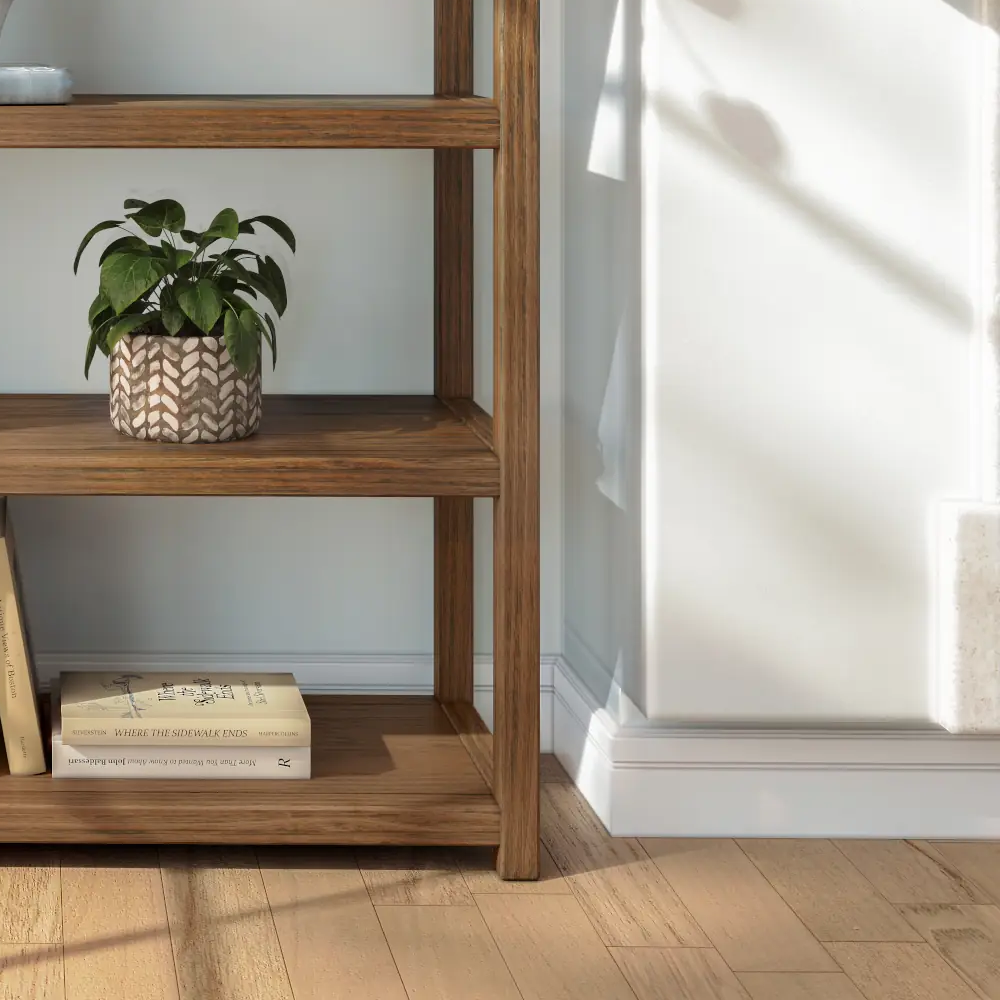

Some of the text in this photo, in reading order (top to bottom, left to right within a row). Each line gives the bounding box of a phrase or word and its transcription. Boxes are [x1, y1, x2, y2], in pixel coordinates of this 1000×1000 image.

[1, 631, 10, 658] Views
[6, 658, 13, 670] of
[7, 669, 17, 699] Boston
[157, 682, 177, 701] Where
[193, 678, 216, 706] Sidewalk
[114, 728, 249, 738] WHERE THE SIDEWALK ENDS
[68, 758, 107, 766] Baldessari
[108, 758, 126, 766] John
[149, 758, 168, 766] Know
[206, 759, 218, 767] You
[220, 759, 237, 767] Than
[239, 759, 256, 767] More
[277, 758, 291, 768] R
